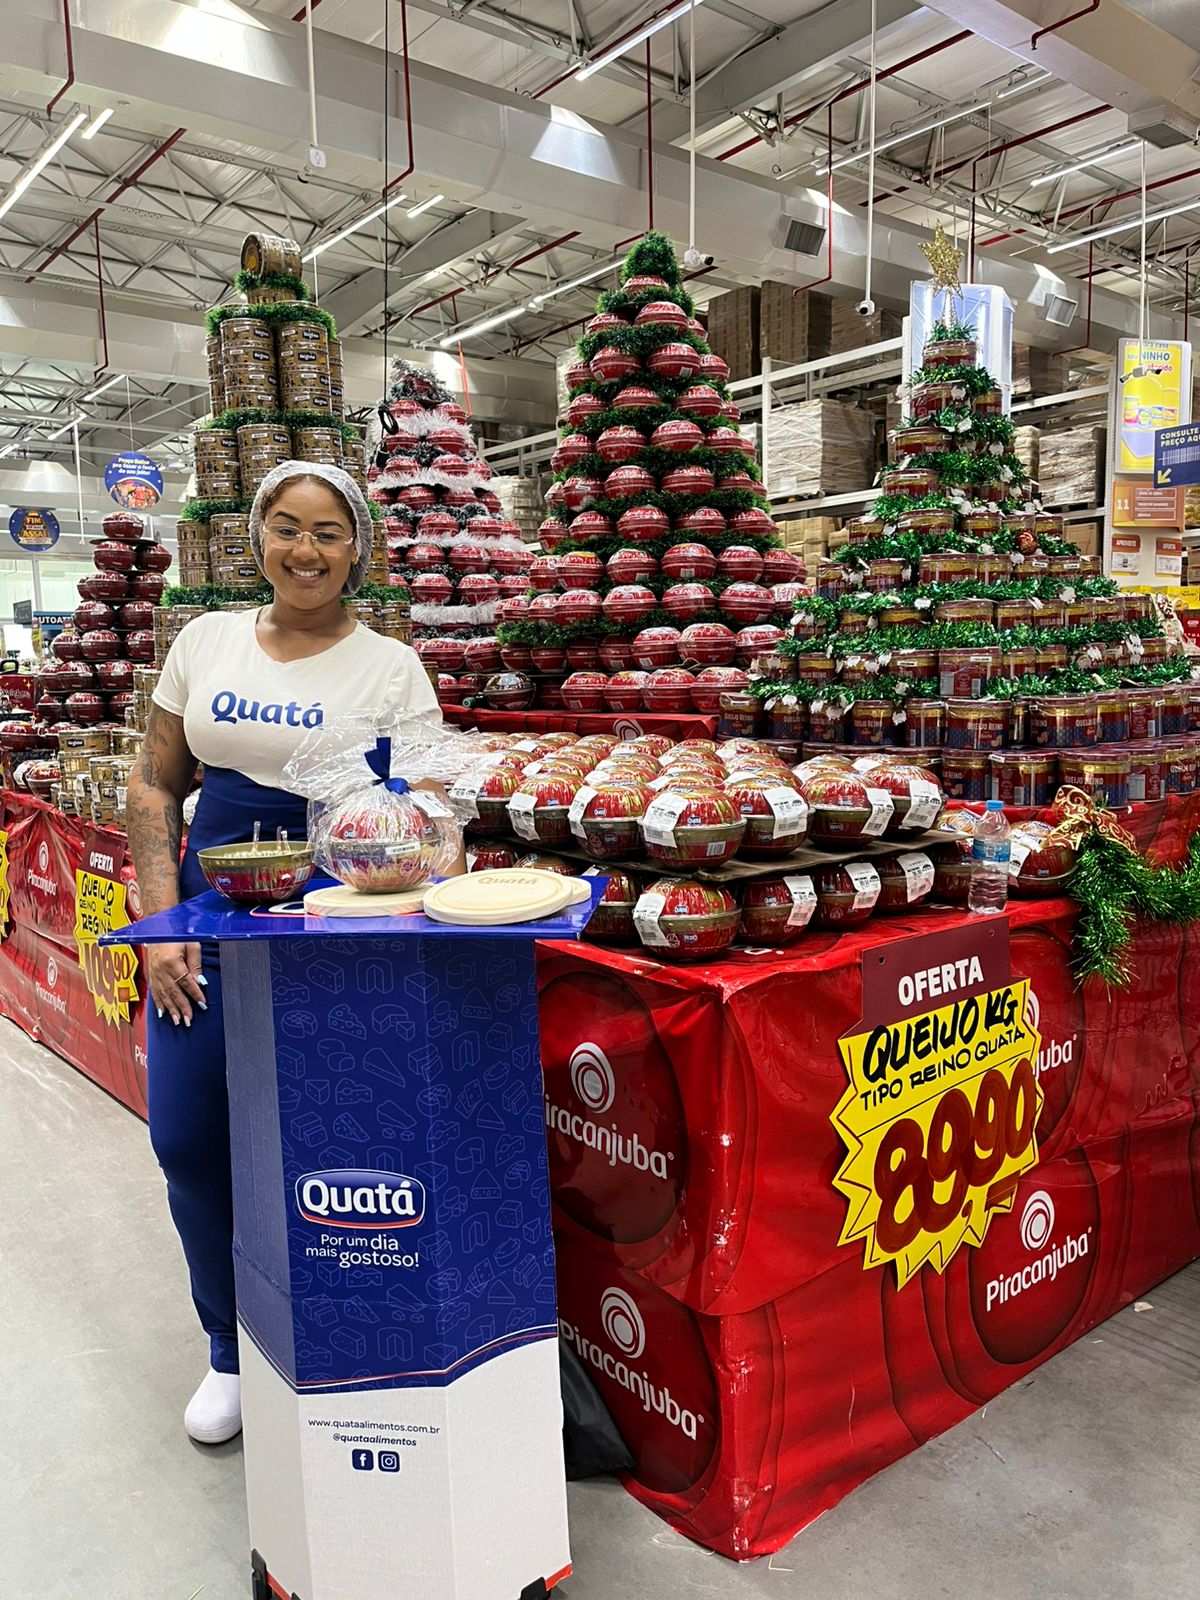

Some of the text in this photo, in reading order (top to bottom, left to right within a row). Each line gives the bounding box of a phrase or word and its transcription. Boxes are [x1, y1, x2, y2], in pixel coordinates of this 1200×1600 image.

[1160, 427, 1199, 440] CONSULTE
[1160, 437, 1185, 447] PREÇO
[1116, 499, 1129, 510] 11
[211, 690, 324, 730] Quatá
[89, 851, 114, 873] OFERTA
[898, 956, 985, 1006] OFERTA
[862, 988, 1018, 1083] QUEIJO KG
[860, 1078, 903, 1111] TIPO
[909, 1048, 971, 1089] REINO
[545, 1094, 670, 1180] iracanjuba
[302, 1179, 416, 1216] Quatá
[321, 1233, 399, 1251] Por um dia
[306, 1245, 420, 1268] mais gostoso!
[986, 1234, 1090, 1312] Piracanjuba
[308, 1419, 441, 1435] www.quataalimentos.com.br
[333, 1432, 417, 1447] @quataalimentos
